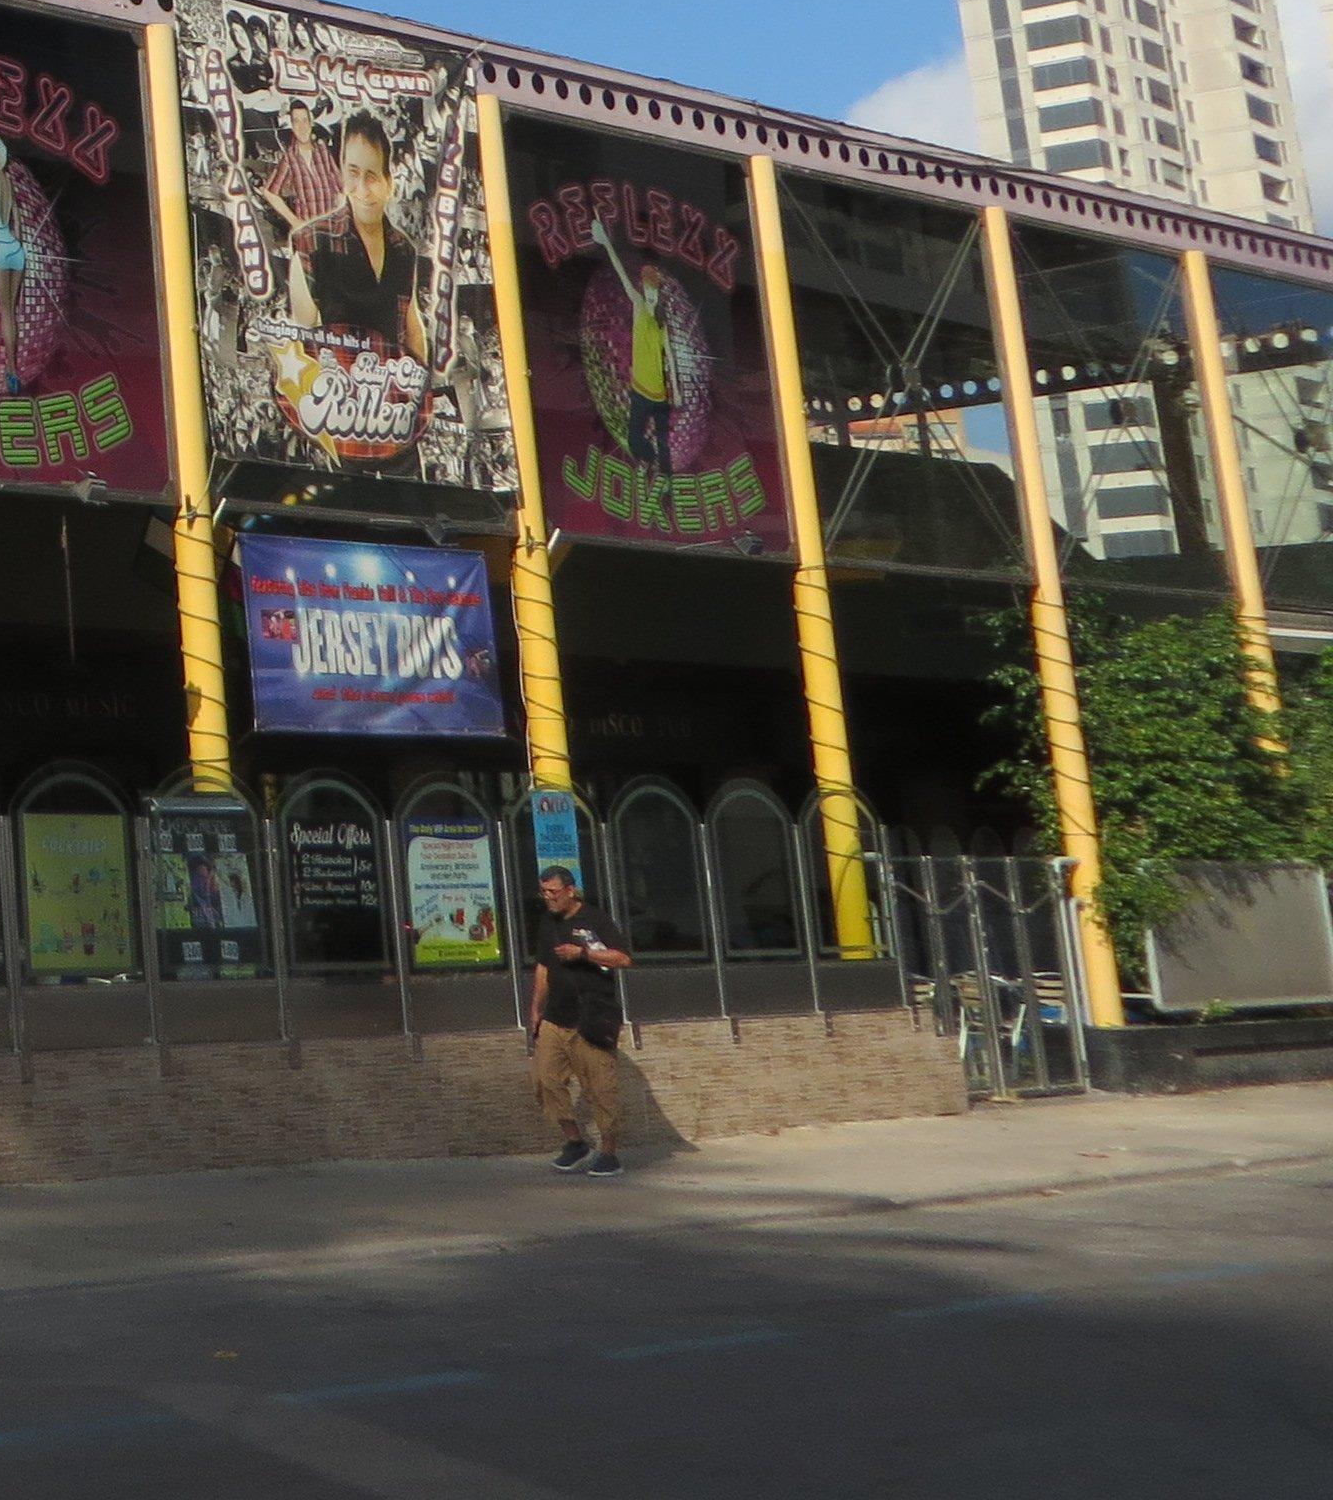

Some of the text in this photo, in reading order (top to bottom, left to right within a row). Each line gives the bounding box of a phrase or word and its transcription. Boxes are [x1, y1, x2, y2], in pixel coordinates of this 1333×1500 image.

[299, 369, 417, 438] Rollers
[562, 443, 766, 534] JOKERS
[291, 607, 464, 681] JERSEY BOYS
[290, 822, 372, 851] Special Offers
